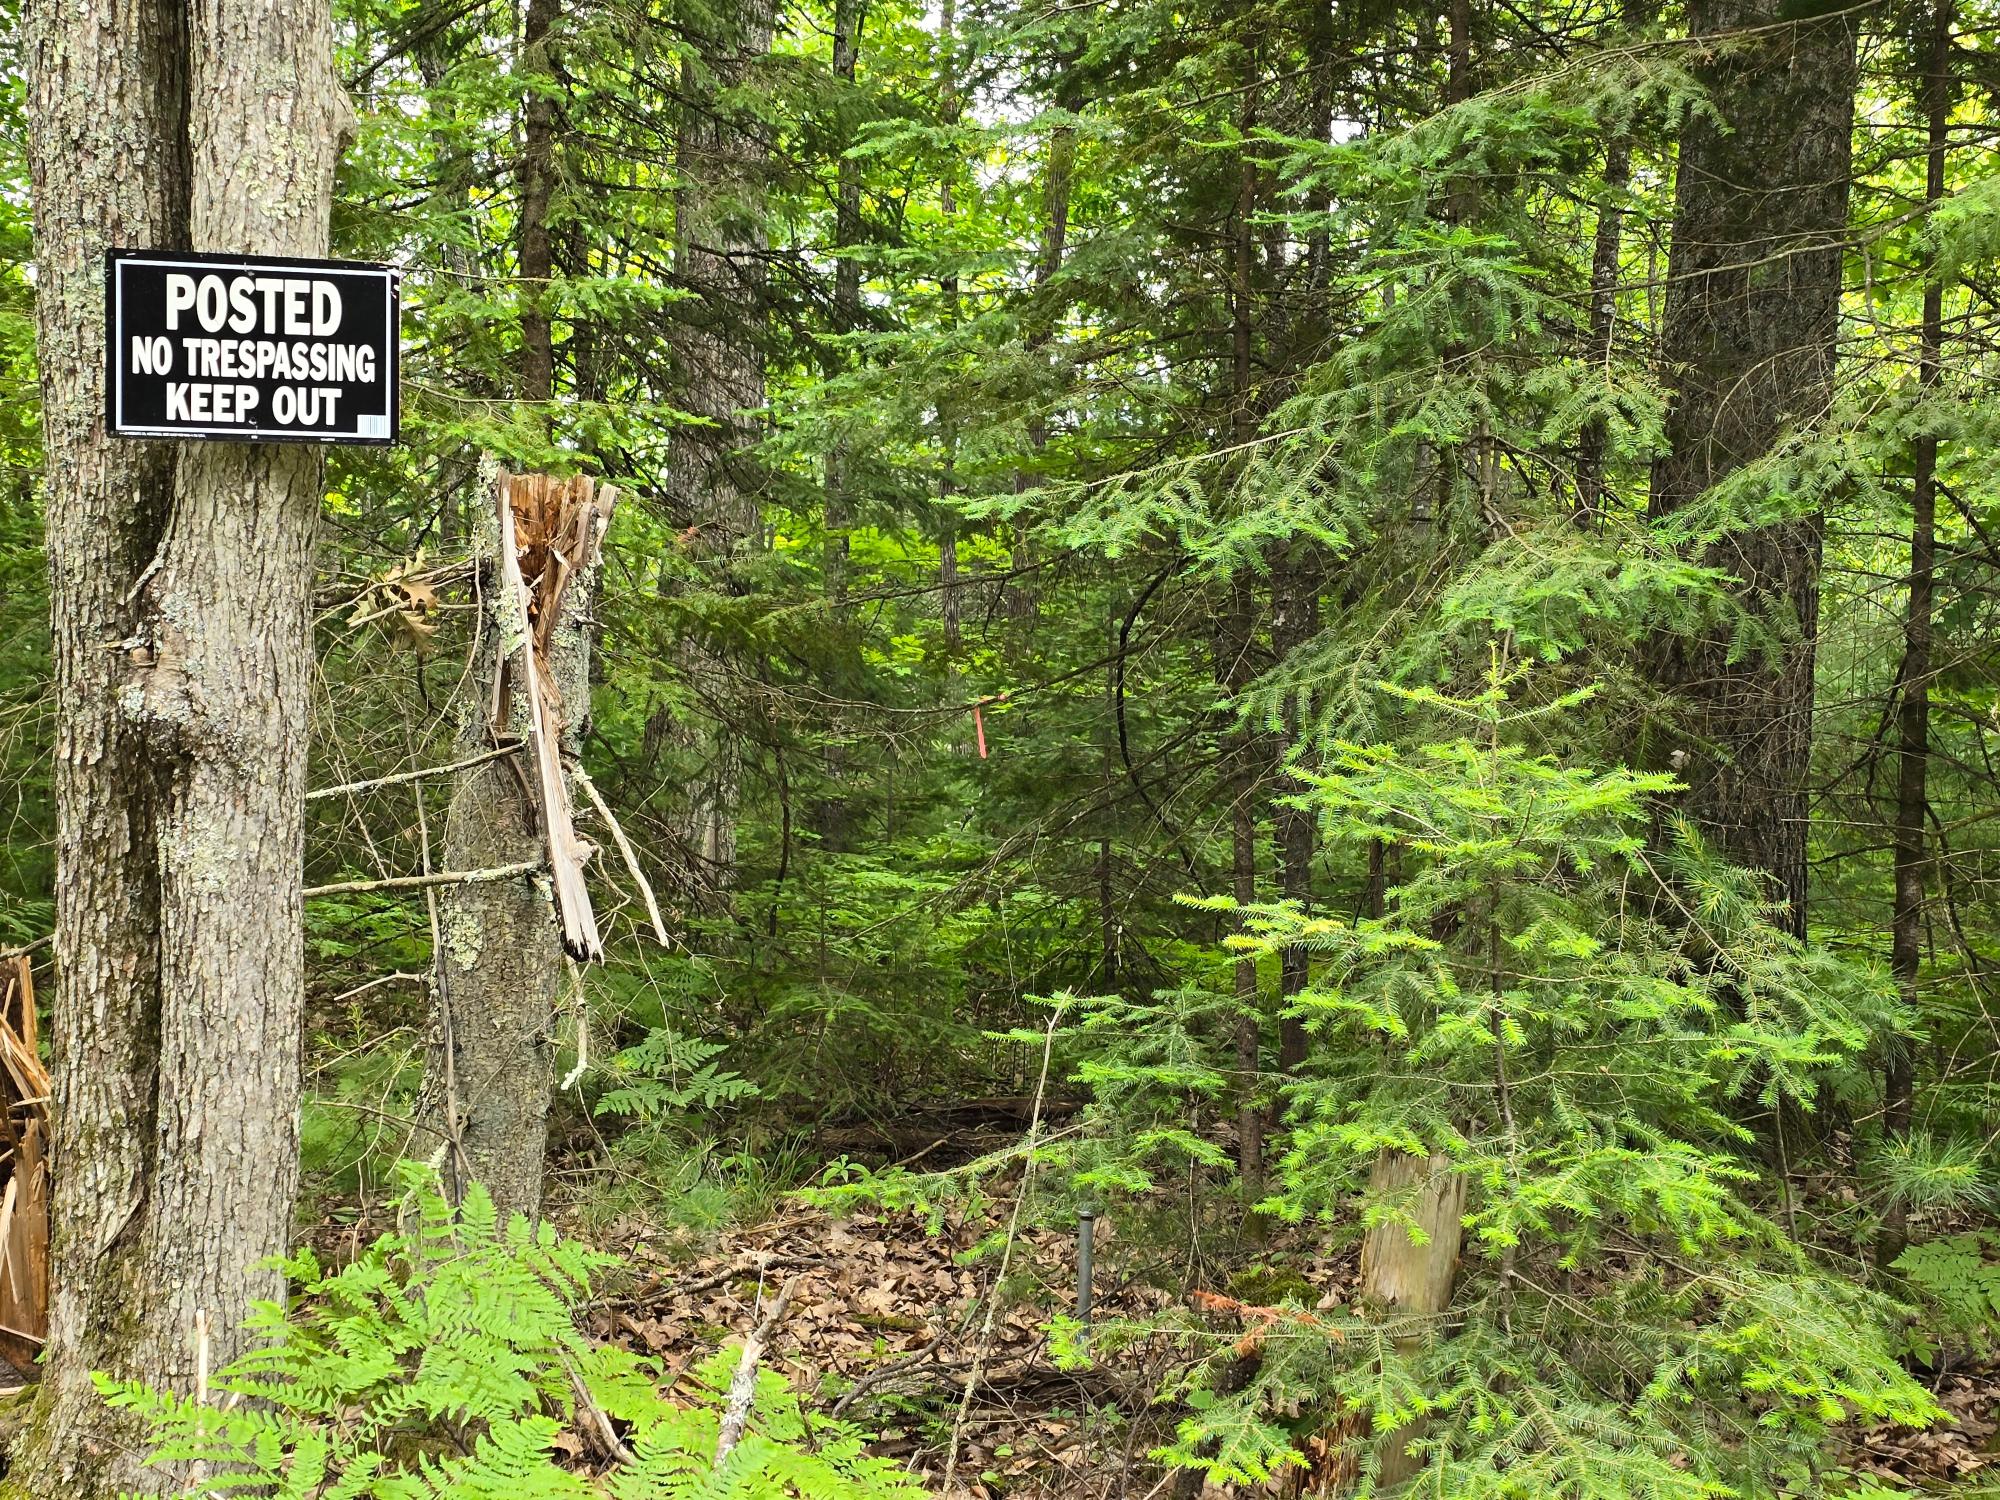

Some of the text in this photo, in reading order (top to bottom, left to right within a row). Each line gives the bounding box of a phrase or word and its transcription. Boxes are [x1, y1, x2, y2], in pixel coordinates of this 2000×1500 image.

[166, 274, 342, 336] POSTED
[132, 336, 375, 383] NO TRESPASSING
[166, 383, 342, 425] KEEP OUT
